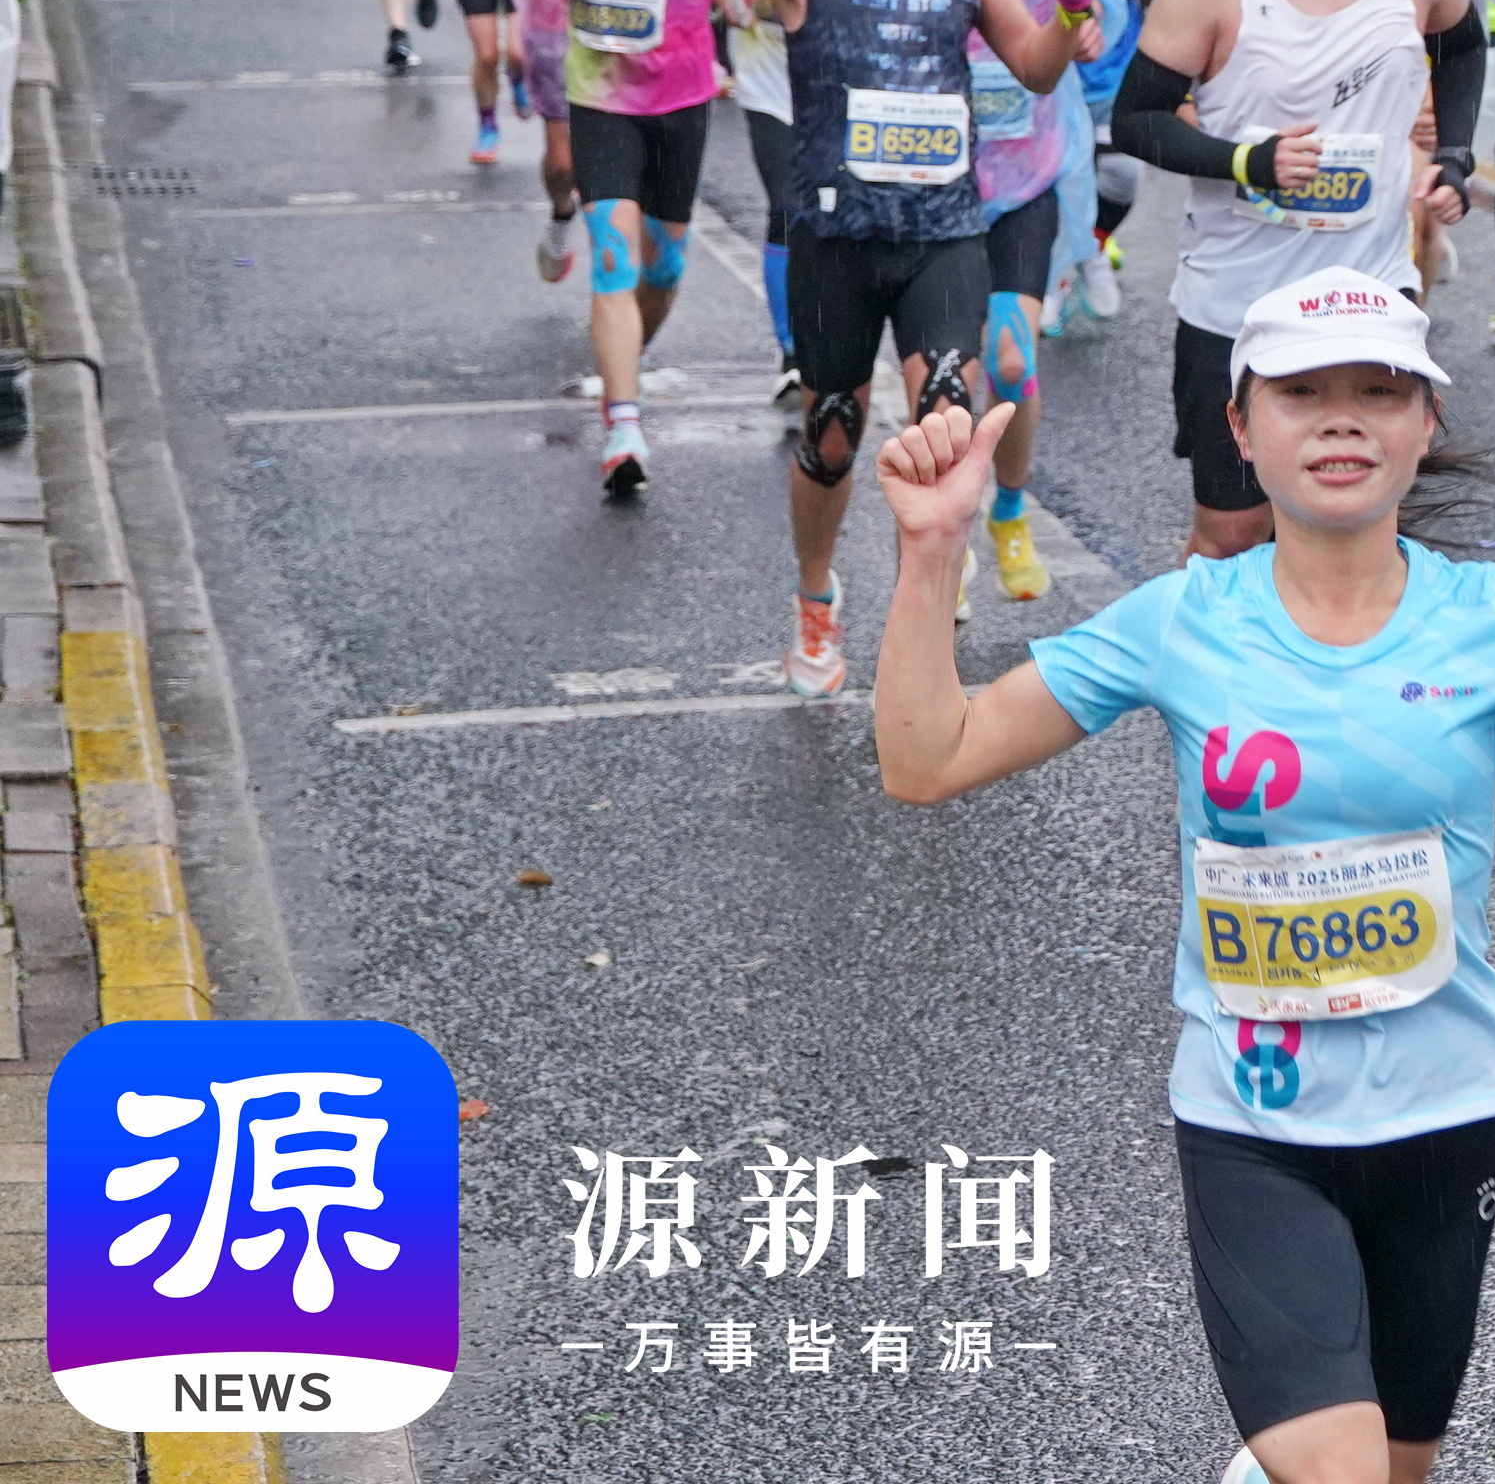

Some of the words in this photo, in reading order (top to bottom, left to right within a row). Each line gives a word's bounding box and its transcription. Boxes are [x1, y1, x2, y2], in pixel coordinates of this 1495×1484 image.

[850, 122, 877, 153] B
[883, 126, 959, 156] 65242
[1297, 848, 1428, 886] 2025丽水马拉松
[1206, 907, 1248, 965] B
[1256, 899, 1420, 963] 76863
